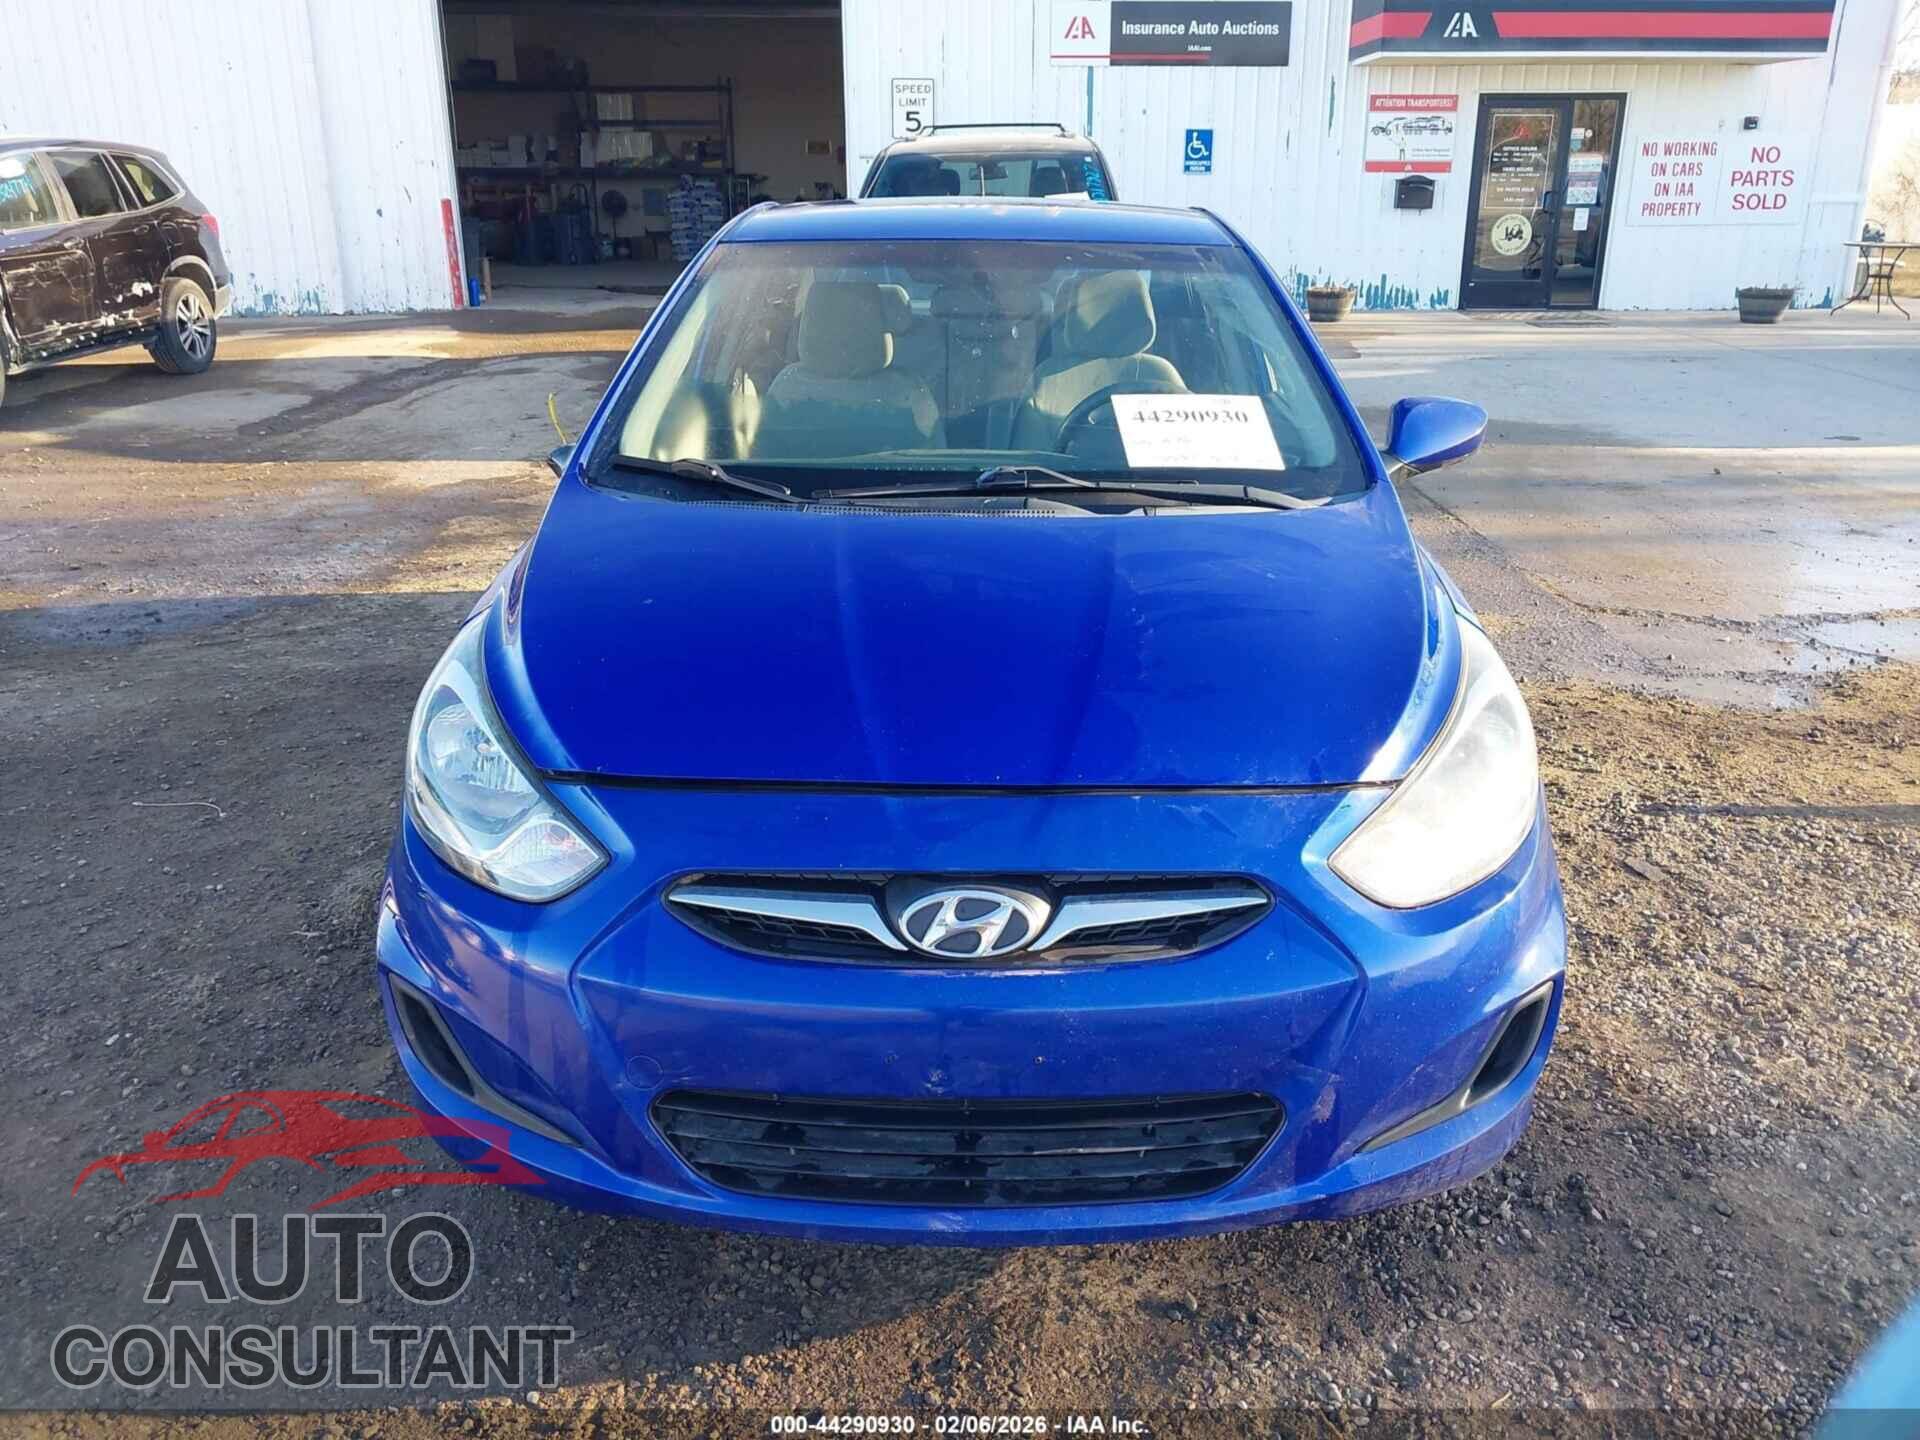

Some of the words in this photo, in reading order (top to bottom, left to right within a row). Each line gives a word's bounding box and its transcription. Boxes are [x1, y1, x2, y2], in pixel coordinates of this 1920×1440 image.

[1121, 20, 1185, 35] Insurance
[1188, 20, 1220, 35] Auto
[1222, 20, 1280, 35] Auctions
[895, 84, 931, 94] SPEED
[898, 97, 928, 107] LIMIT
[905, 111, 921, 132] 5
[1641, 142, 1658, 157] NO
[1663, 142, 1718, 157] WORKING
[1751, 146, 1781, 163] NO
[1651, 162, 1667, 177] ON
[1672, 162, 1703, 177] CARS
[1730, 169, 1795, 187] PARTS
[1654, 182, 1669, 197] ON
[1674, 182, 1694, 197] IAA
[1731, 193, 1787, 210] SOLD
[1641, 202, 1701, 217] PROPERTY
[1132, 409, 1249, 424] 44290930
